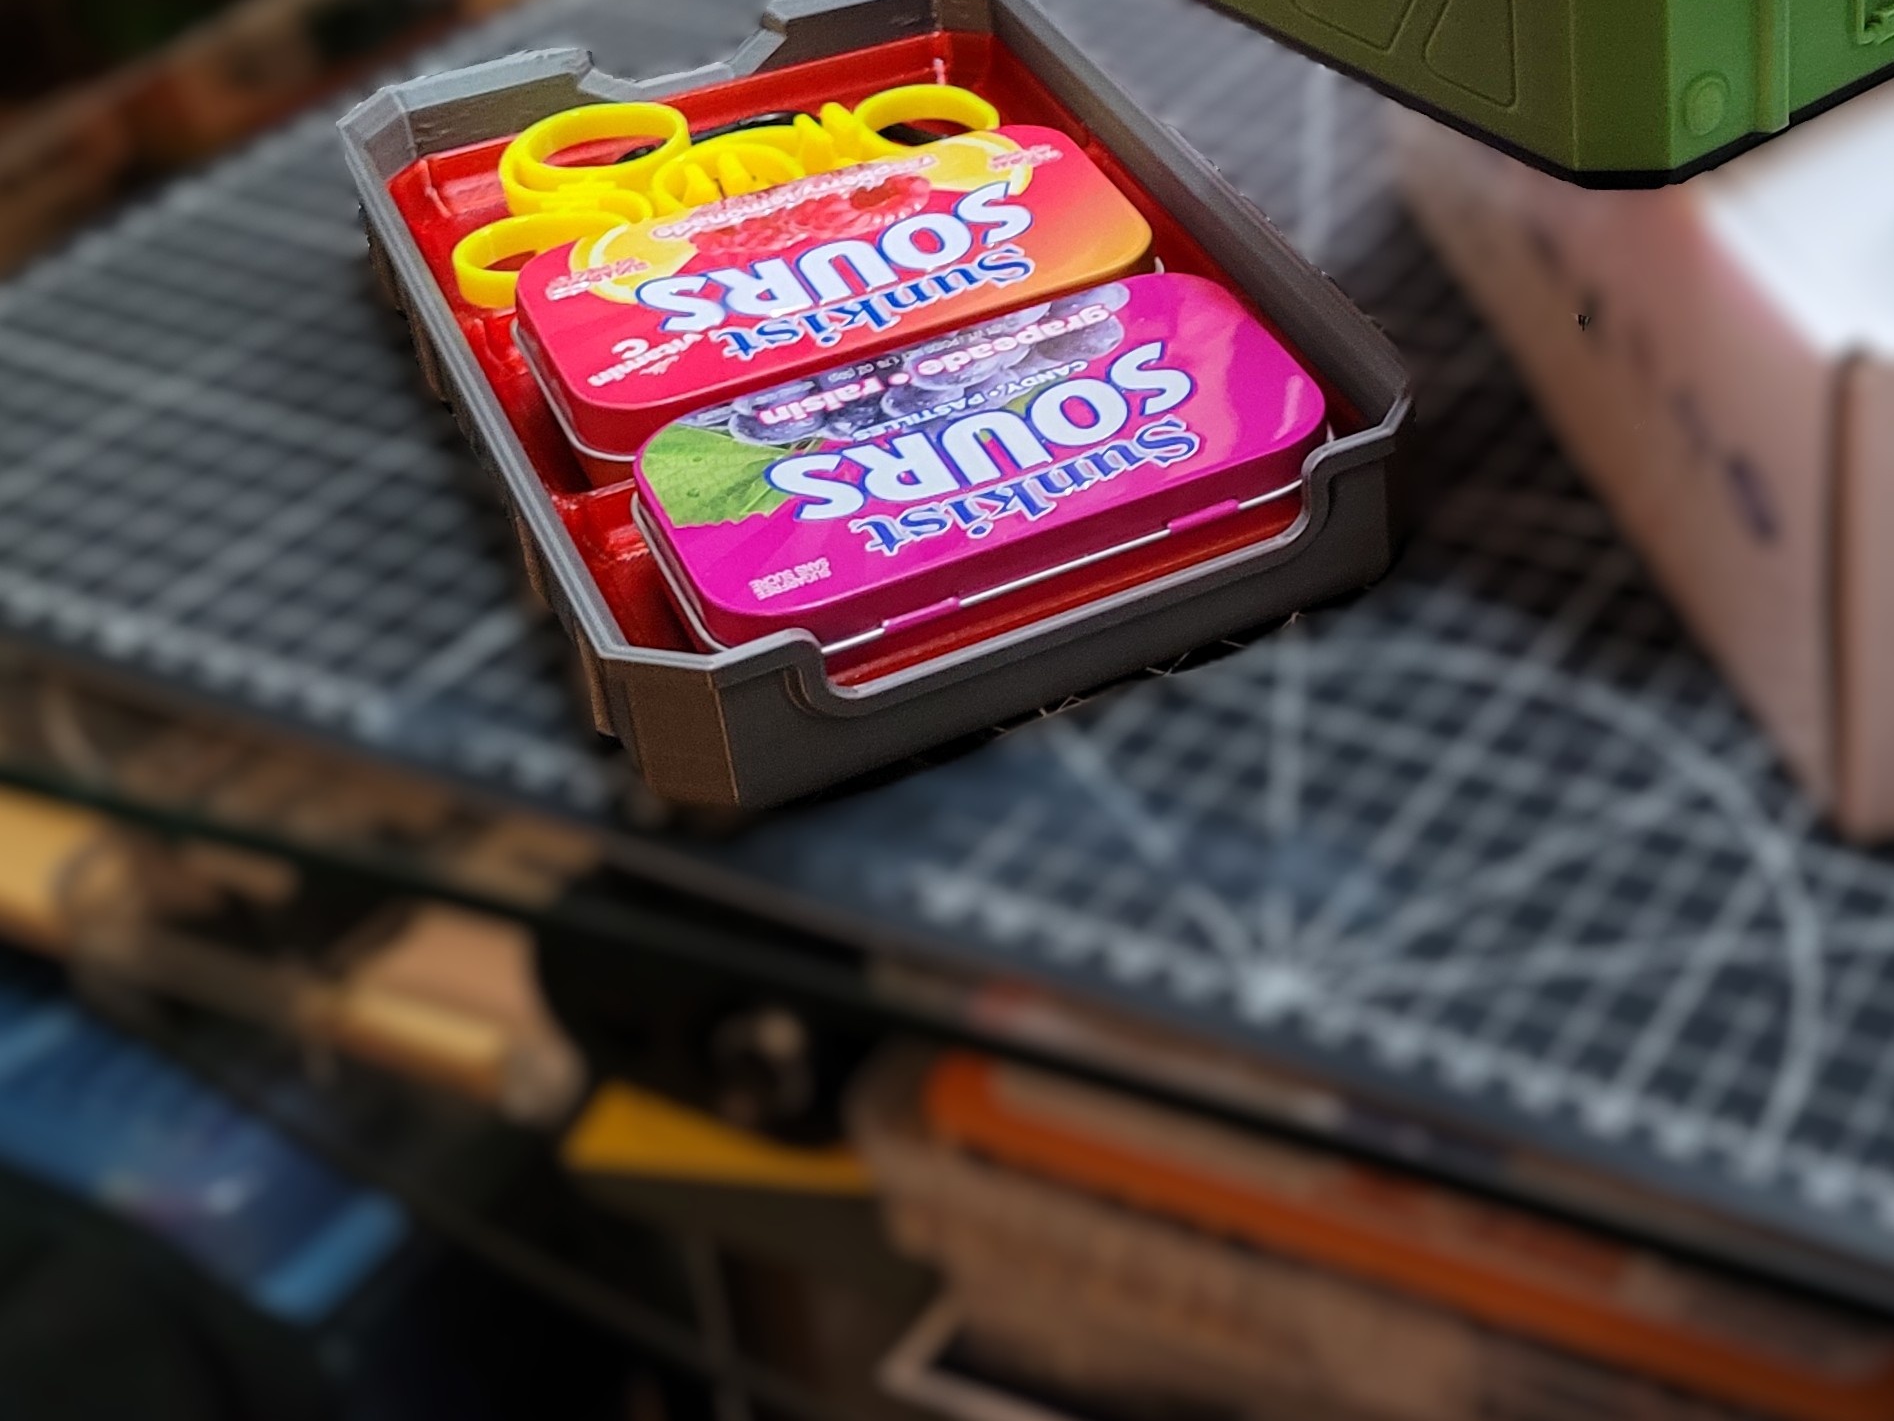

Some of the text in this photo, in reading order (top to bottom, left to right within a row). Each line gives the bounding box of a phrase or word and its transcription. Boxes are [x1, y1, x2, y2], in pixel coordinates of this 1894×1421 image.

[634, 181, 1034, 332] SOURS
[708, 244, 1035, 362] Sunkist
[916, 305, 1110, 376] grapeade
[587, 334, 704, 387] vitamin
[612, 338, 649, 360] C
[758, 377, 883, 425] raisin
[762, 342, 1194, 521] SOURS
[851, 360, 1088, 442] CANDY PASTILLES
[850, 416, 1199, 556] Sunkist
